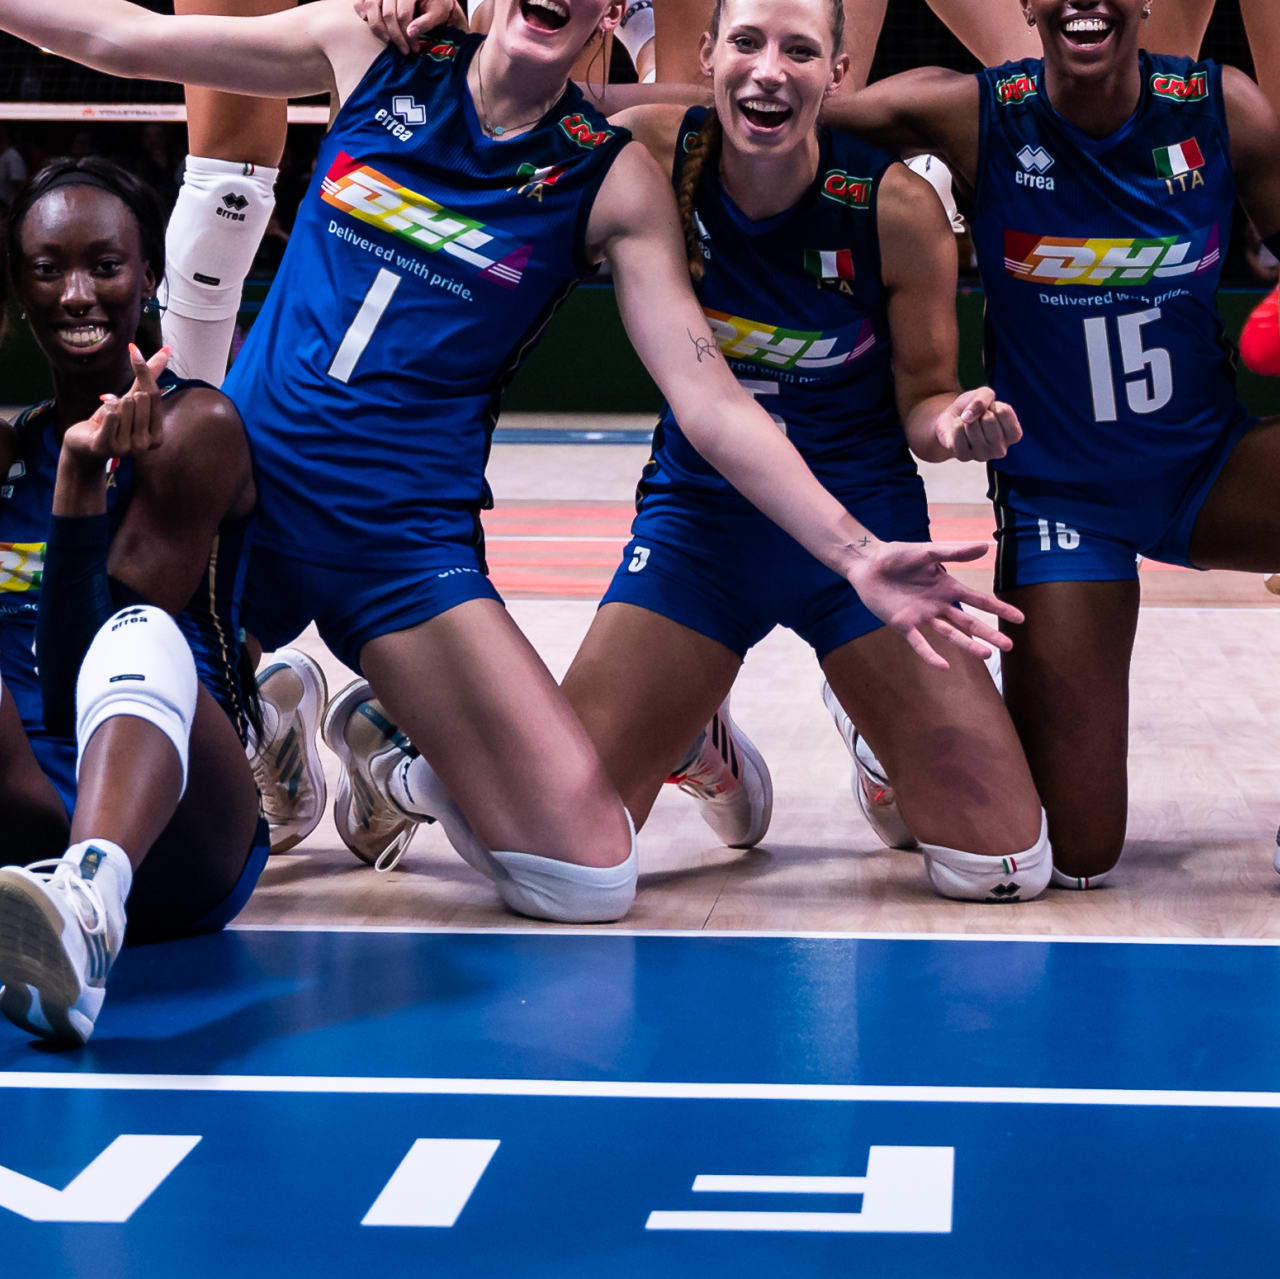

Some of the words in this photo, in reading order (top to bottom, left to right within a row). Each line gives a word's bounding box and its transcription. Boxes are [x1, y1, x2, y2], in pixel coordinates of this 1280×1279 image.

[335, 170, 494, 269] DHL
[1165, 170, 1204, 195] ITA
[328, 220, 394, 262] Delivered
[395, 252, 429, 280] with
[430, 269, 473, 302] pride.
[1031, 241, 1201, 279] DHL
[1039, 293, 1112, 306] Delivered
[327, 266, 402, 383] 1
[1082, 307, 1173, 422] 15
